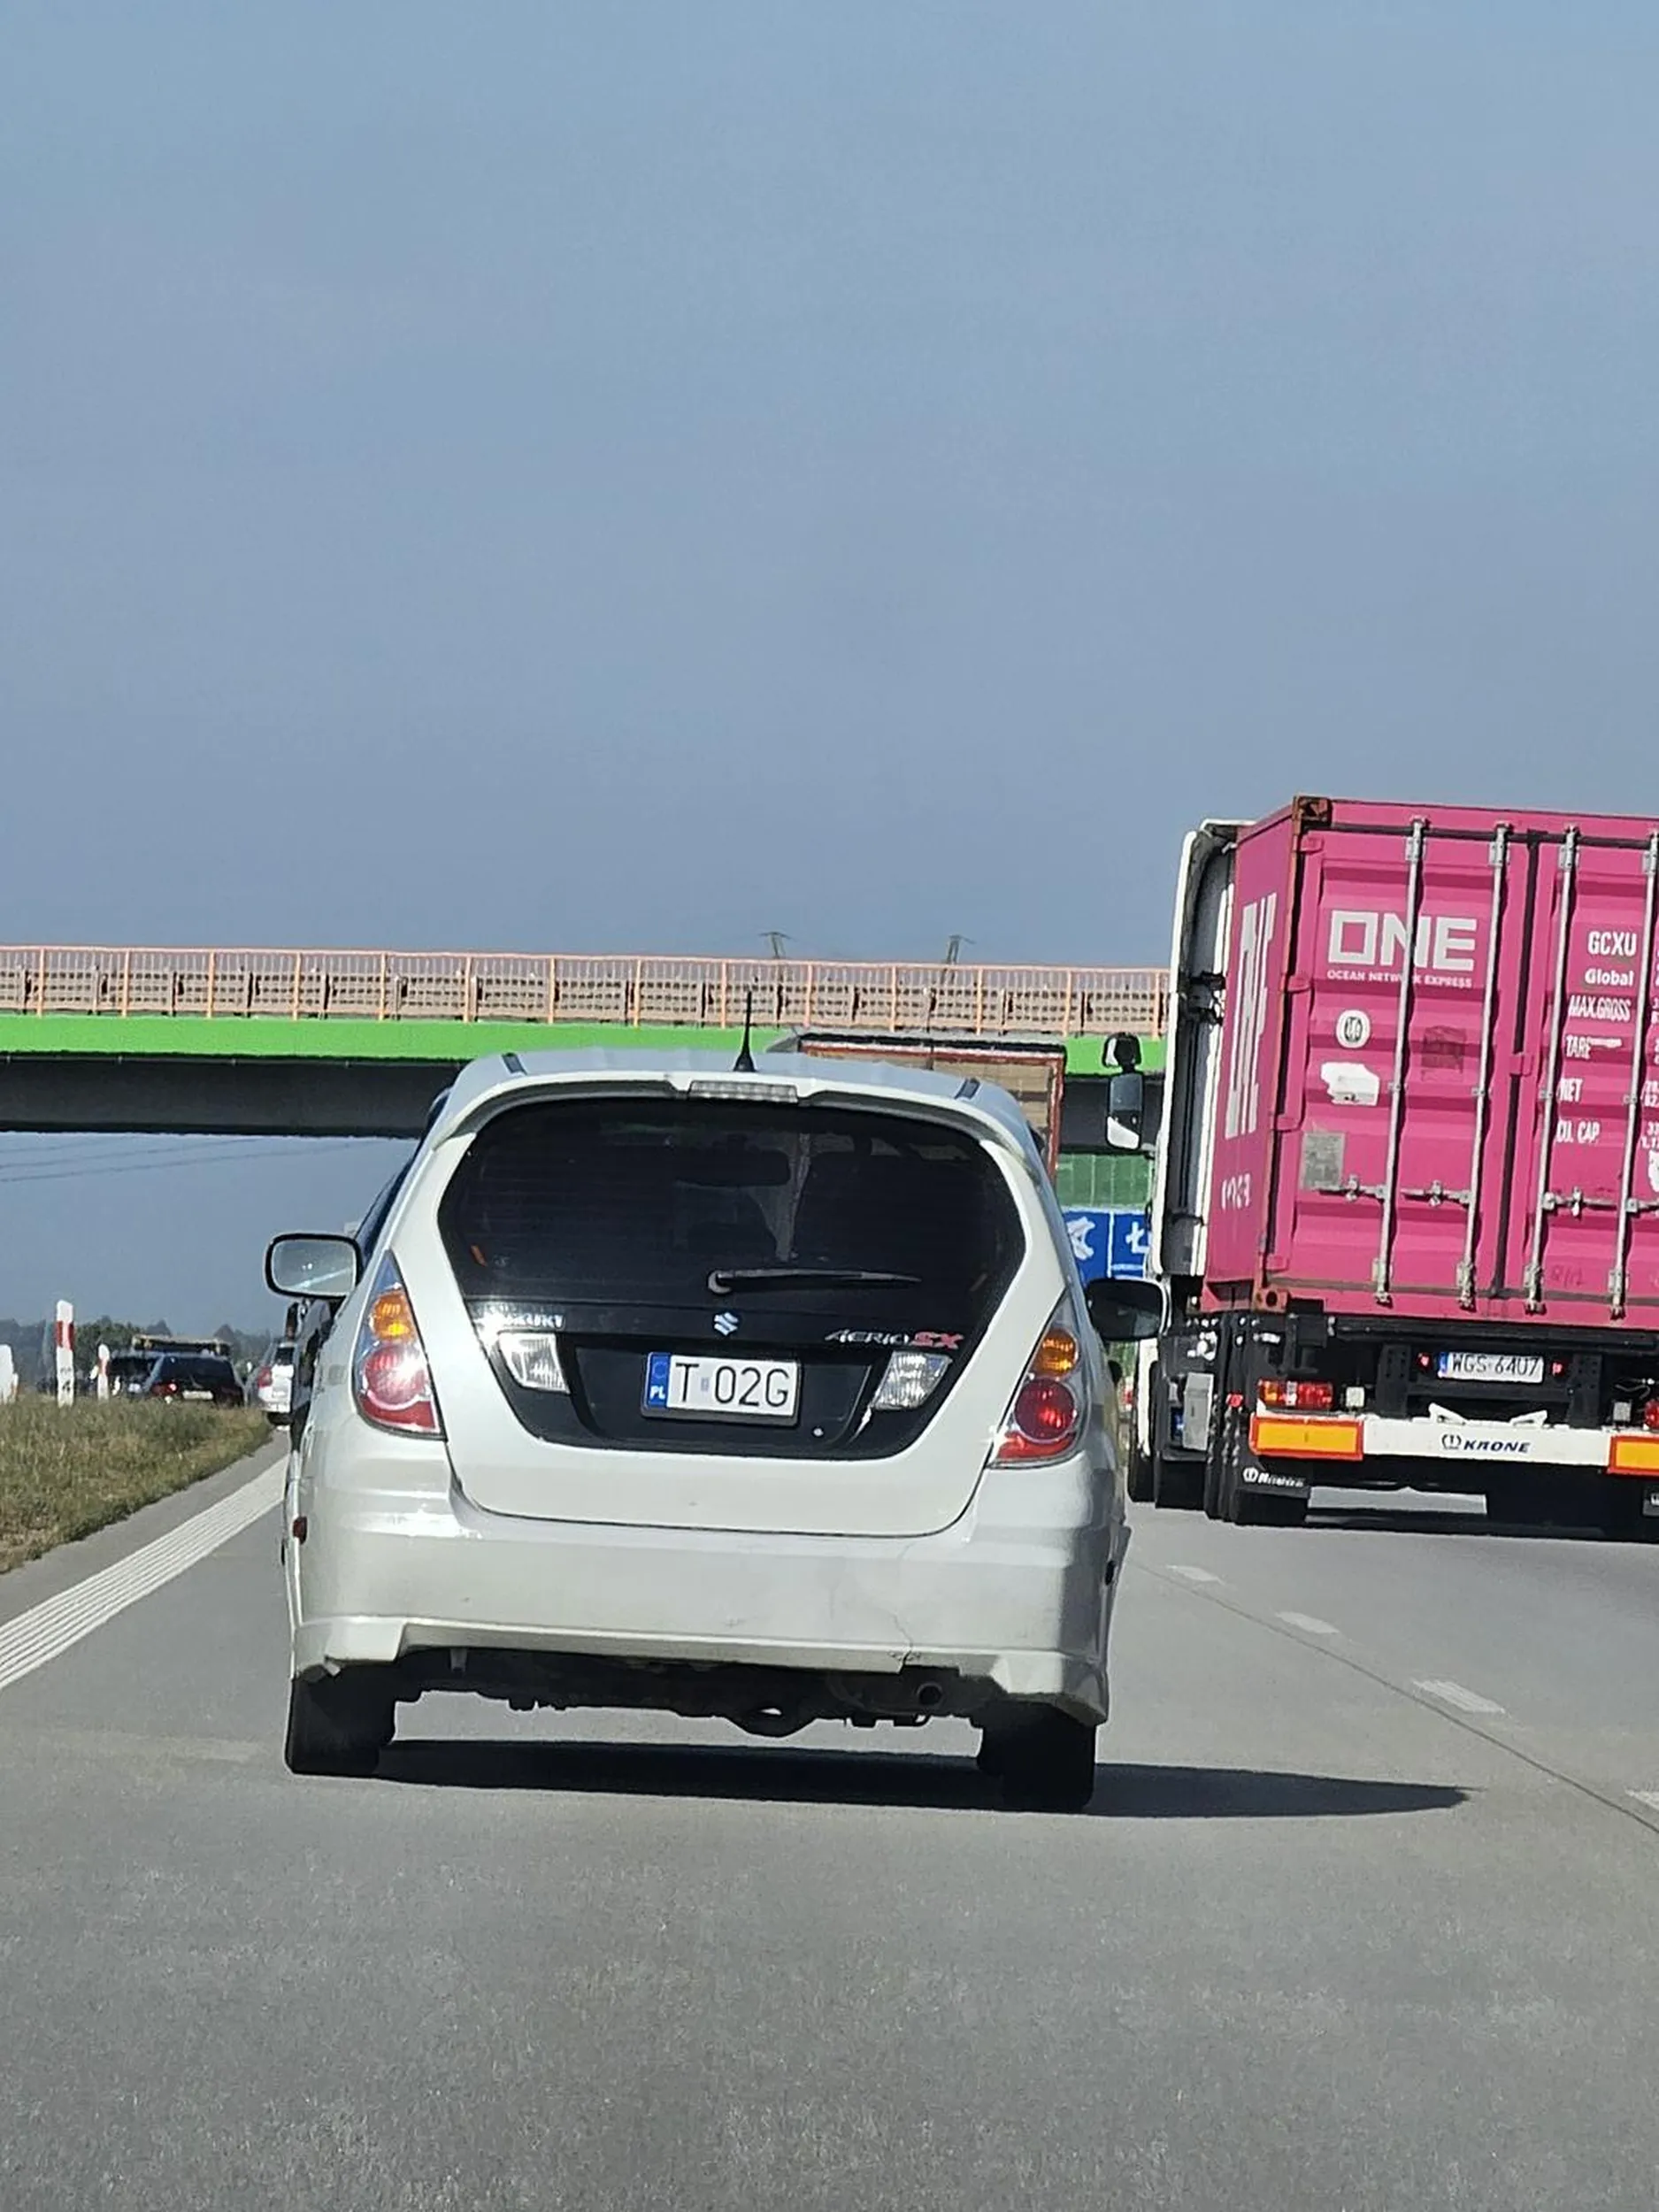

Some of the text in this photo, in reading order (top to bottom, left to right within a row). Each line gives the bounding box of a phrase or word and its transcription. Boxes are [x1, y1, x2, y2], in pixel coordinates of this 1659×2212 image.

[1328, 910, 1477, 971] ONE
[1587, 930, 1637, 956] GCXU
[1327, 969, 1472, 988] OCEAN NETWK EXPRESS
[1584, 968, 1634, 987] Global
[1565, 1034, 1592, 1059] TARE
[1557, 1078, 1583, 1102] NET
[824, 1329, 964, 1349] AERIO SX
[1452, 1352, 1487, 1373] WGS
[649, 1386, 666, 1401] PL
[675, 1362, 789, 1408] T 02G
[1463, 1439, 1531, 1454] KRONE
